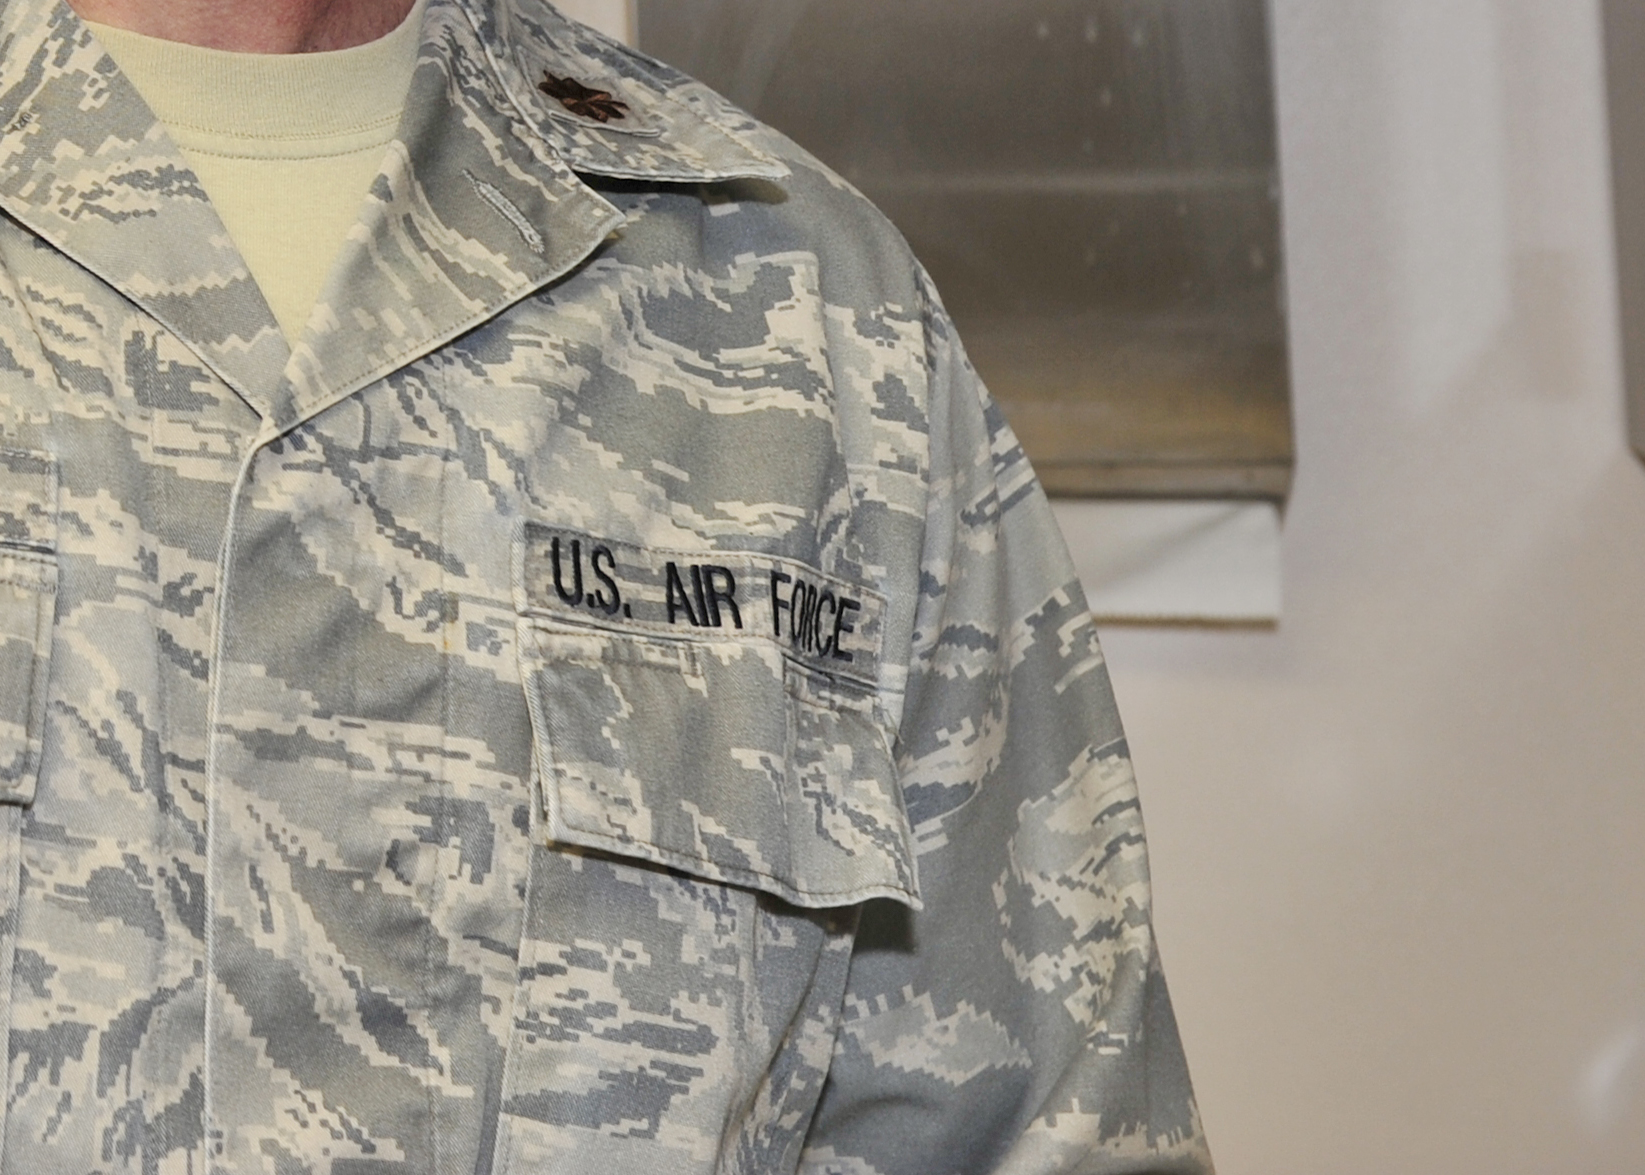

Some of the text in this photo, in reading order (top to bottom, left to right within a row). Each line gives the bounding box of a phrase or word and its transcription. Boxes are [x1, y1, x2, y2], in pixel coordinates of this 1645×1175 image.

[551, 537, 861, 662] U.S. AIR FORCE
